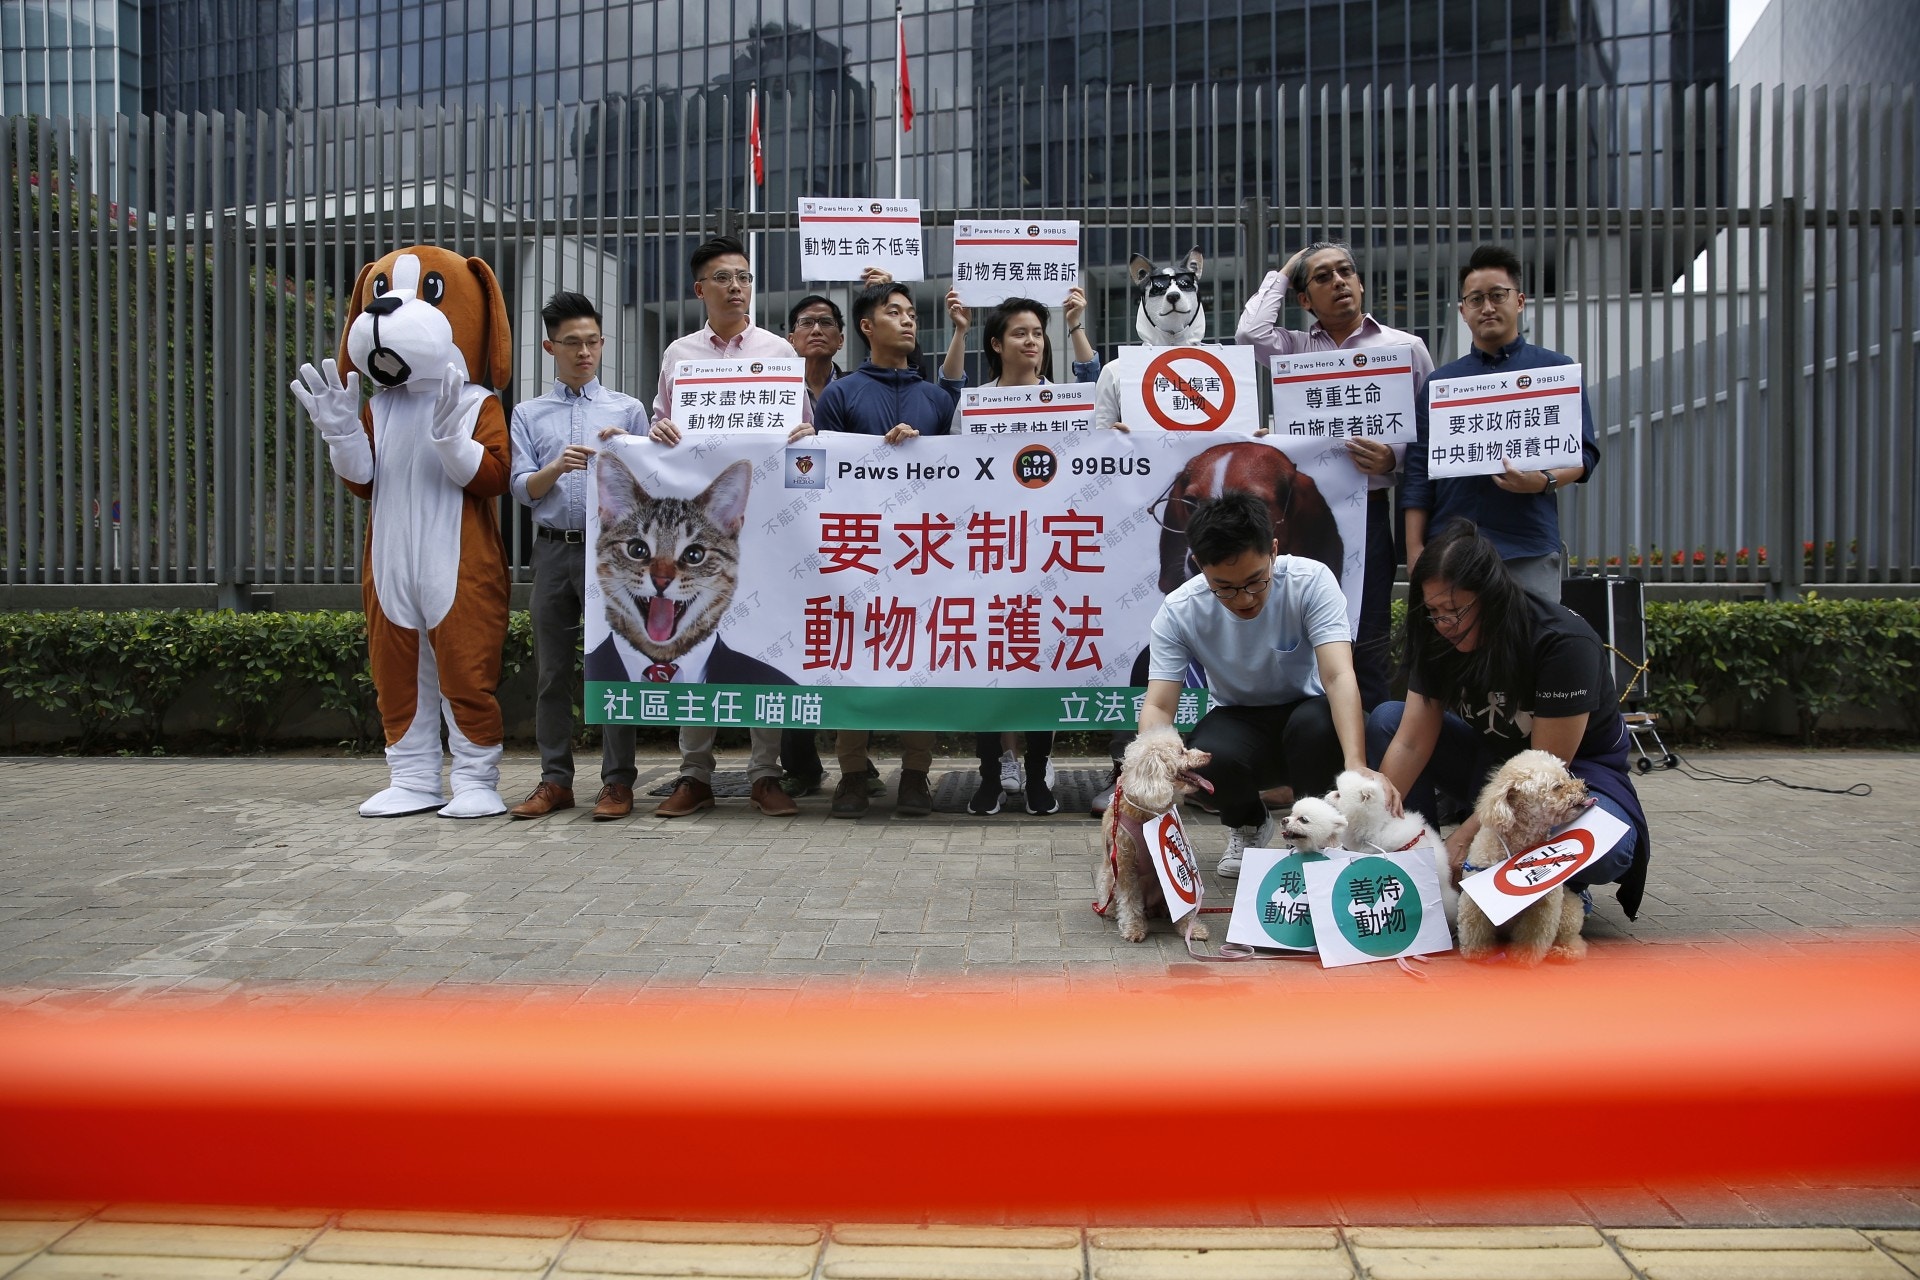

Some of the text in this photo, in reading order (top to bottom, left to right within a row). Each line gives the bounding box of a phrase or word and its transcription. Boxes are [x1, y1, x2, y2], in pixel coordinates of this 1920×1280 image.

[1014, 227, 1021, 235] X
[804, 237, 920, 257] 動物生命不低等
[957, 262, 1077, 282] 動物有冤無路訴
[736, 365, 743, 373] X
[1338, 358, 1345, 367] X
[1371, 354, 1398, 363] 99BUS
[1155, 377, 1221, 392] 停止傷害
[1453, 386, 1475, 394] Paws
[1500, 380, 1508, 389] X
[1536, 374, 1566, 384] 99BUS
[680, 389, 797, 408] 要求盡快制定
[1025, 393, 1032, 401] X
[1057, 392, 1082, 400] 99BUS
[1172, 395, 1206, 411] 動物
[1305, 382, 1382, 409] 尊重生命
[687, 412, 785, 430] 動物保護法
[1449, 404, 1561, 436] 要求政府設置
[1431, 433, 1581, 466] 中央動物領養中心
[838, 456, 1151, 481] Paws Hero X 99BUS
[1032, 455, 1051, 466] 99
[1023, 466, 1050, 478] BUS
[818, 508, 1106, 576] 要求制定
[802, 594, 1104, 673] 動物保護法
[603, 688, 823, 725] 社區主任 喵喵
[1058, 690, 1216, 725] 立法議
[1349, 874, 1401, 906] 善待
[1263, 901, 1311, 927] 動保
[1354, 907, 1407, 938] 動物
